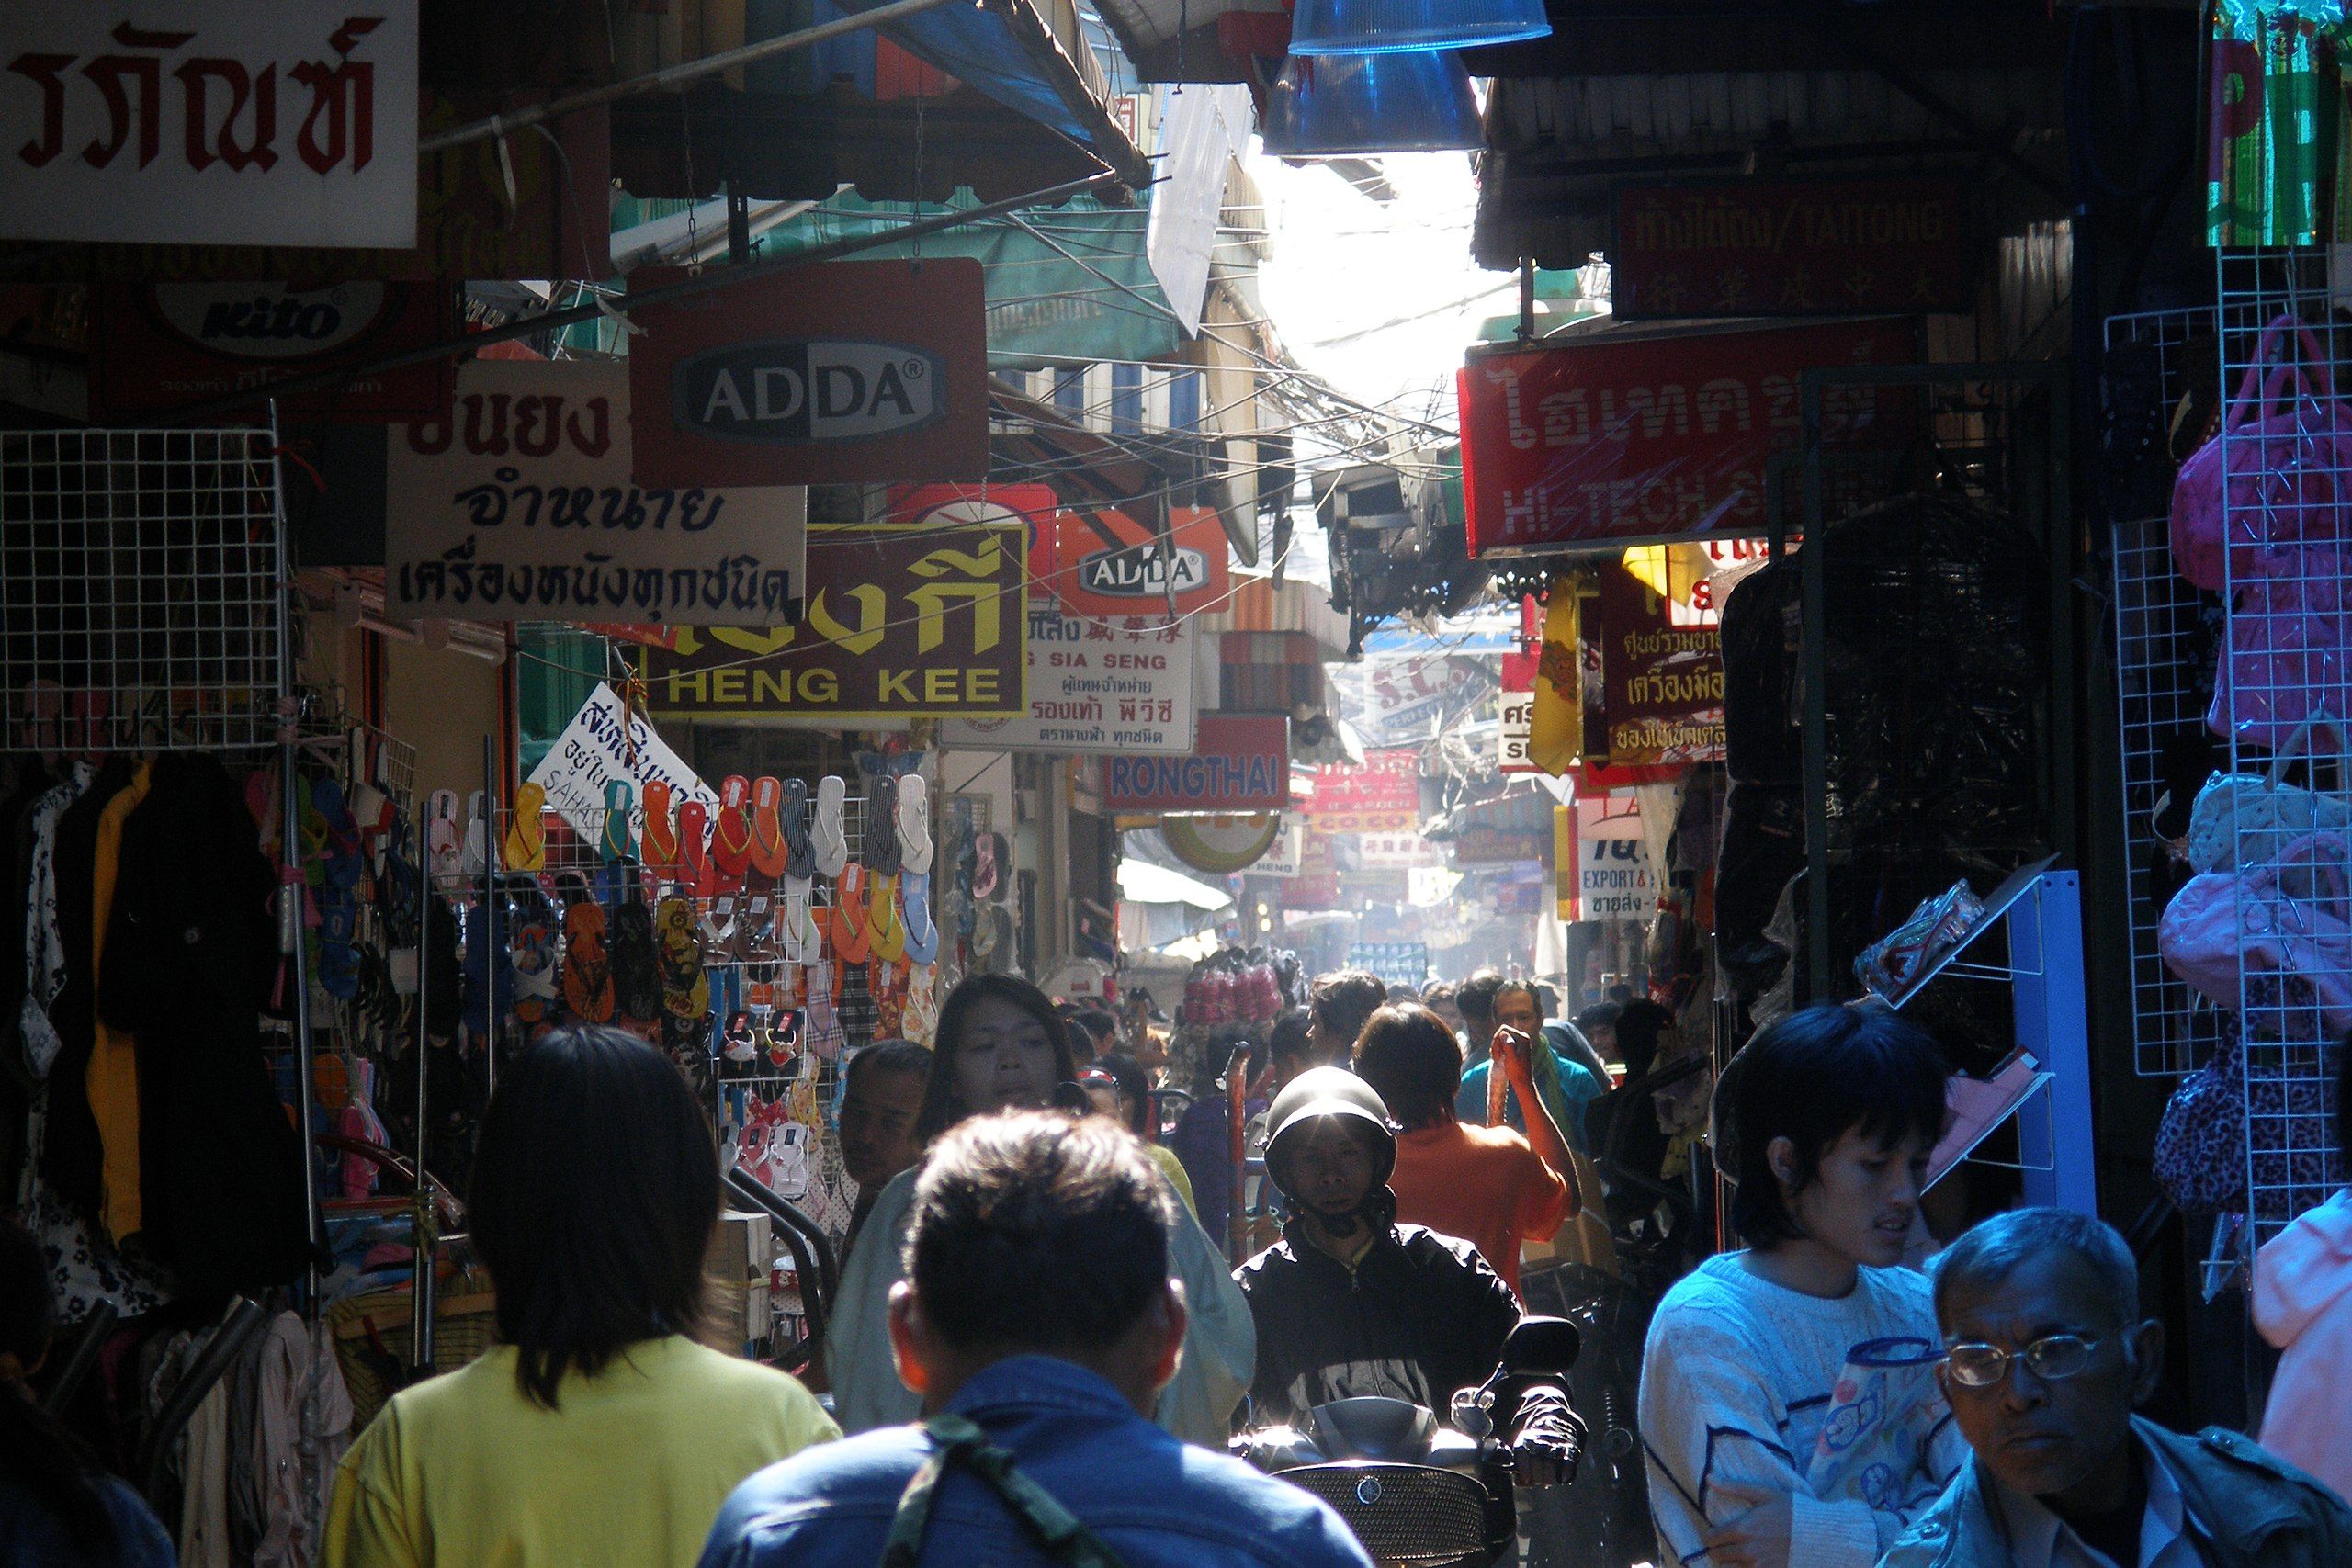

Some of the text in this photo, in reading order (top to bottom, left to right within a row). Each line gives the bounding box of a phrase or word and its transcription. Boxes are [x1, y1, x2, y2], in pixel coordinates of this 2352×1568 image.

[202, 297, 341, 340] Kito
[1504, 472, 1707, 535] HI-TECH
[1050, 652, 1087, 668] SIA
[1104, 653, 1167, 670] SENG
[668, 668, 1001, 704] HENG KEE
[1062, 676, 1152, 695] ผู้แทนจำหน่าย
[1031, 695, 1102, 720] รองเท้า
[1112, 730, 1163, 746] ทุกชนิด
[1111, 755, 1278, 797] RONGTHAI
[1583, 870, 1634, 888] EXPORT
[1637, 870, 1646, 887] &
[1592, 893, 1642, 912] ขายส่ง
